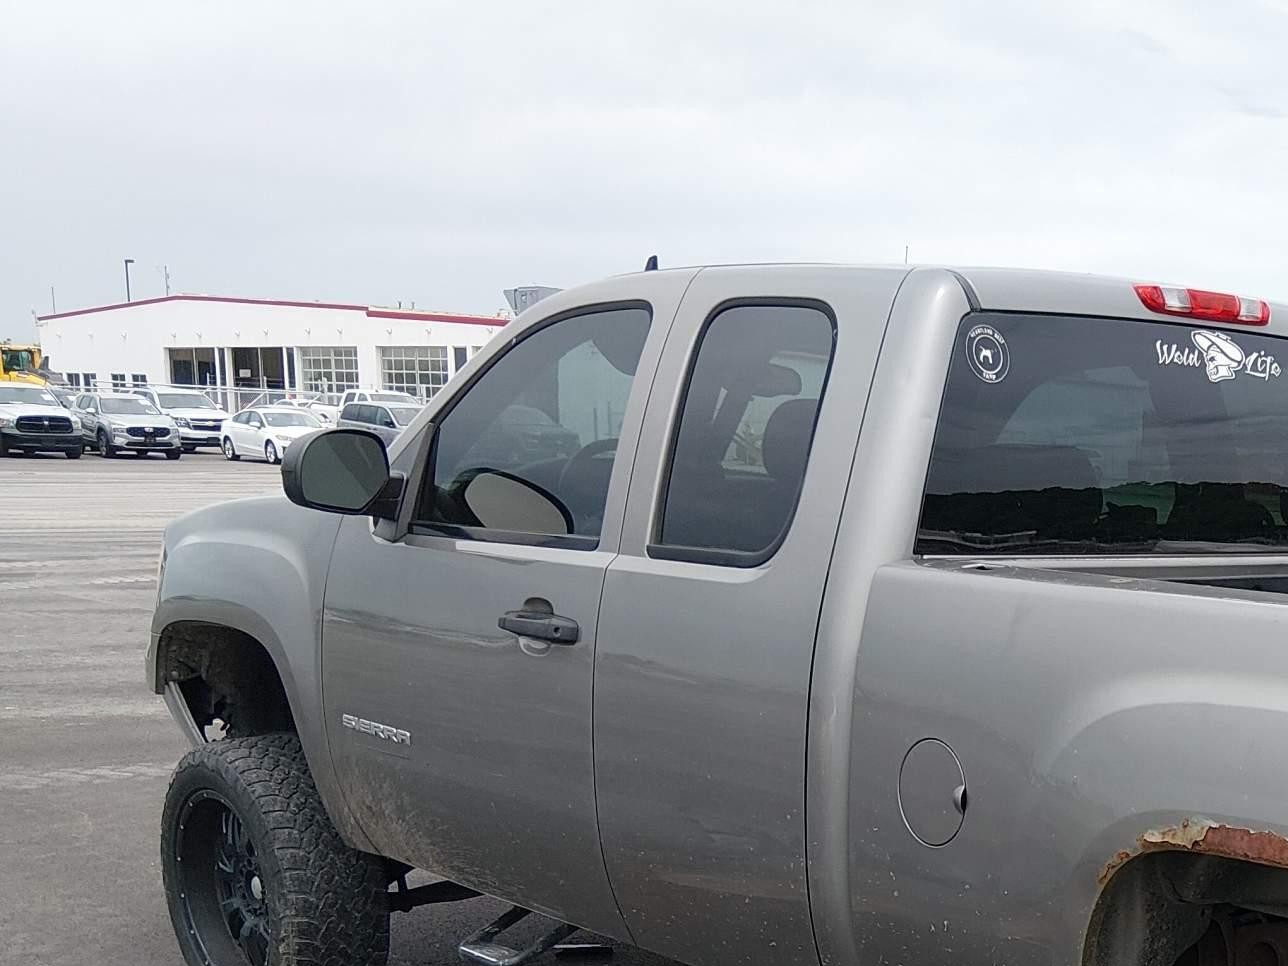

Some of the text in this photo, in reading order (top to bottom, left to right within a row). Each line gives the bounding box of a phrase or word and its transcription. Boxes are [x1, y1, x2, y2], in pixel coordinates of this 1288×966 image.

[1156, 339, 1282, 381] Weld Life
[342, 713, 411, 747] SIERRA
